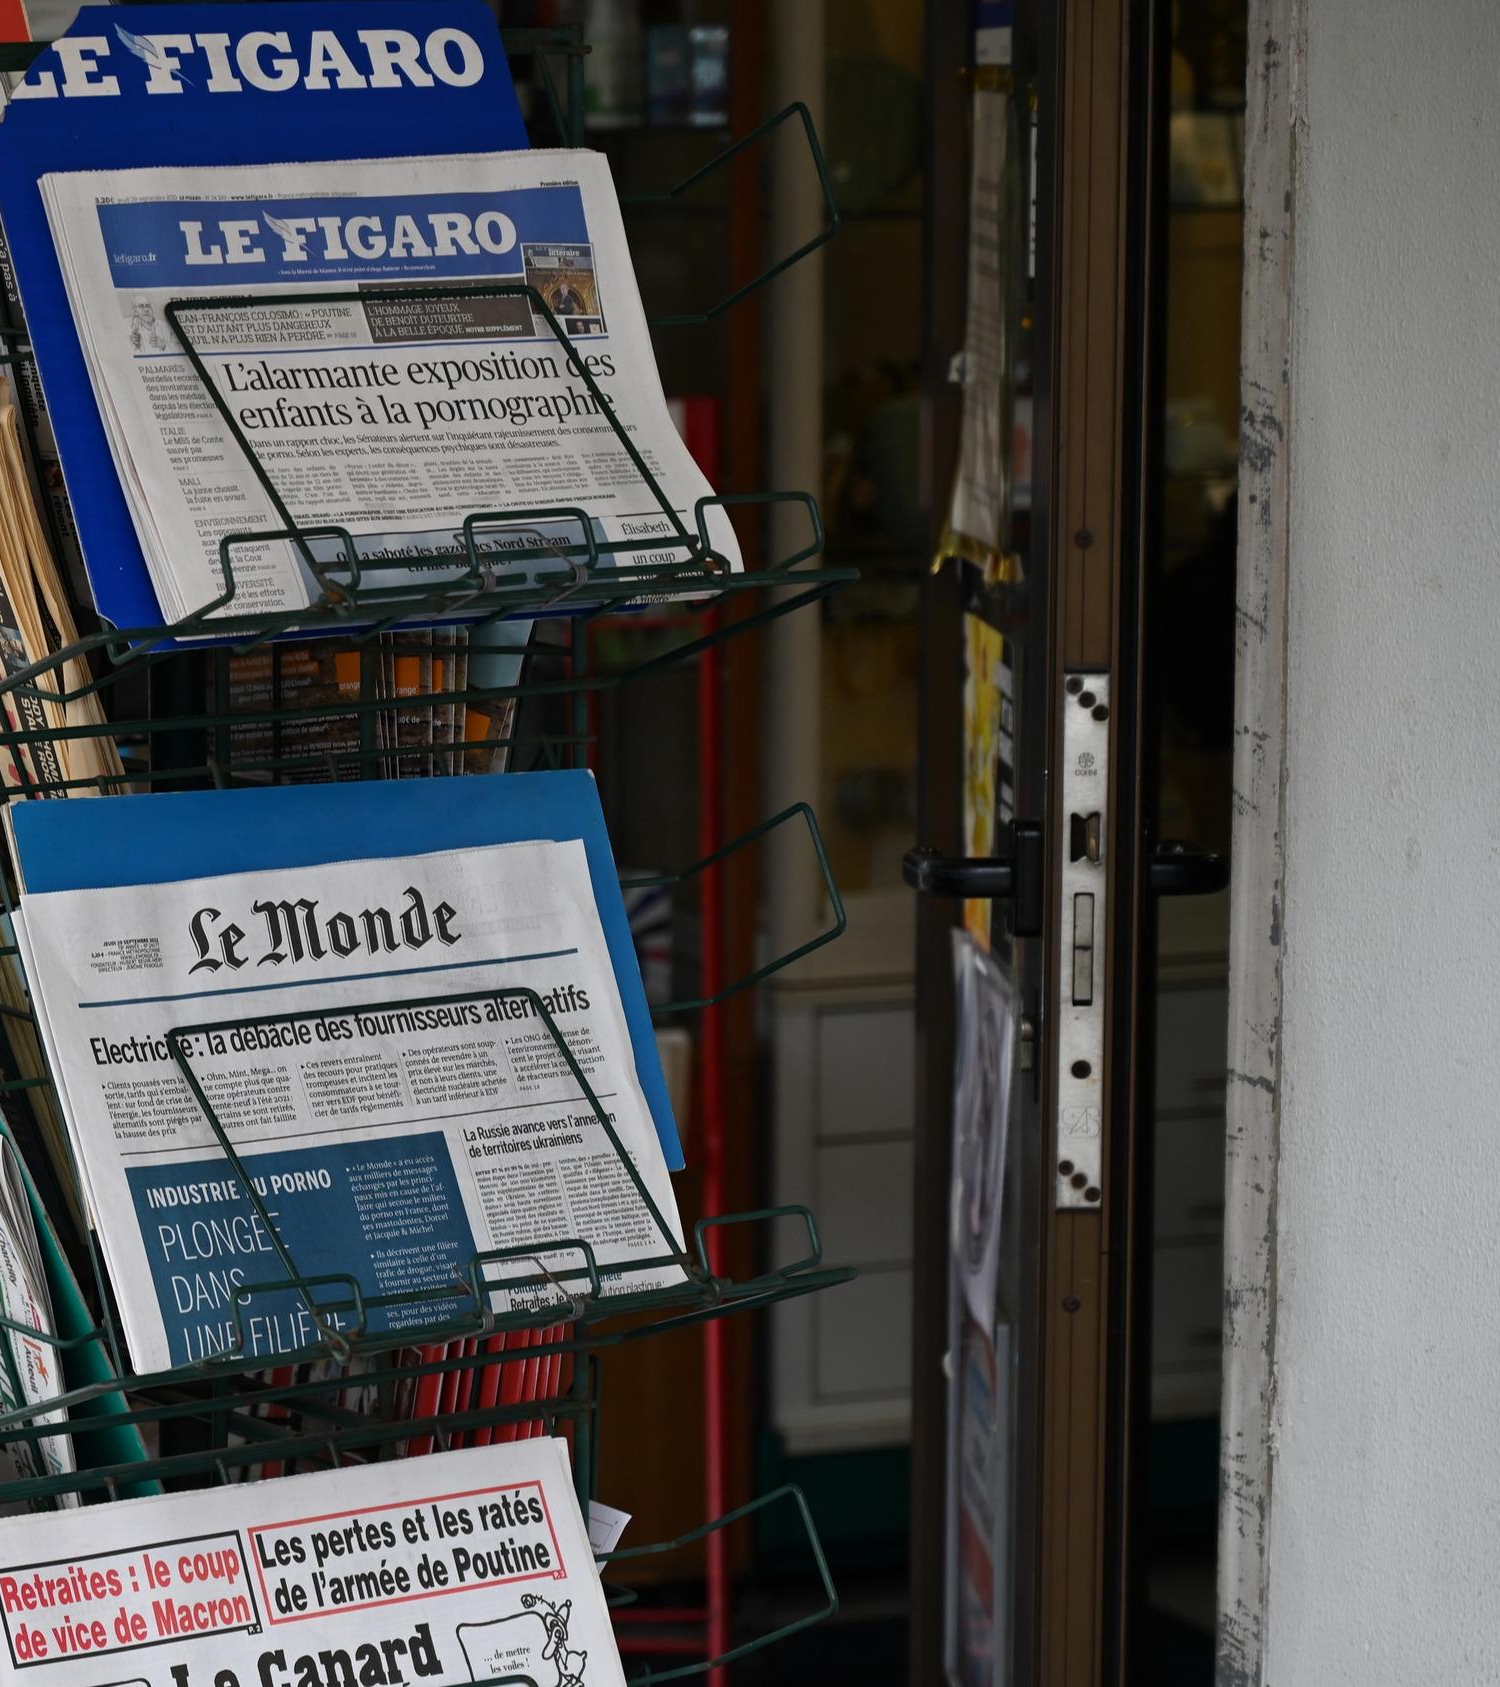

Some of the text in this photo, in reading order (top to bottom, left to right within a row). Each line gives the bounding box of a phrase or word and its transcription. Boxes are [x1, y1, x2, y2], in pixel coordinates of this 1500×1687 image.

[9, 28, 486, 99] LE FIGARO
[179, 211, 517, 265] LE FIGARO
[114, 252, 157, 265] lefigaro.fr
[0, 265, 13, 290] pas
[312, 308, 352, 318] POUTINE
[367, 303, 460, 316] L'HOMMAGE JOYEUX
[371, 317, 384, 327] DE
[421, 313, 475, 324] DUTEURTRE
[197, 319, 332, 334] D'AUTANT PLUS DANGEREUX
[383, 327, 397, 337] LA
[398, 326, 426, 336] BELLE
[427, 323, 464, 335] ÉPOQUE
[221, 360, 401, 392] L'alarmante
[407, 351, 559, 390] exposition
[239, 397, 353, 429] enfants
[357, 397, 377, 424] à
[378, 394, 411, 424] la
[248, 439, 272, 449] Dans
[272, 439, 285, 447] un
[285, 438, 319, 447] rapport
[319, 435, 343, 445] choc,
[342, 434, 356, 444] les
[355, 433, 398, 443] Sénateurs
[397, 432, 431, 442] alertent
[445, 430, 493, 440] l'inquiétant
[493, 427, 556, 438] rajeunissement
[556, 426, 572, 435] des
[621, 521, 671, 535] Élisabeth
[494, 539, 524, 550] Nord
[632, 552, 676, 566] un coup
[188, 907, 249, 975] Le
[251, 886, 462, 968] Monde
[90, 1034, 195, 1065] Electricié
[205, 1030, 226, 1056] la
[230, 1018, 311, 1052] débâcle
[315, 1016, 353, 1042] des
[353, 1002, 482, 1038] fournisseurs
[407, 1040, 497, 1057] Des opérateurs sont soup-
[106, 1081, 131, 1089] Clients
[131, 1077, 160, 1089] poussés
[176, 1075, 184, 1084] la
[463, 1110, 617, 1143] La Russie avance vers l'annexn
[469, 1131, 584, 1158] de territoires ukrainiens
[348, 1165, 437, 1182] aux milliers de messages
[146, 1180, 240, 1209] INDUSTRIE
[271, 1168, 332, 1195] PORNO
[364, 1223, 434, 1240] et Jacquie & Michel
[171, 1267, 253, 1314] DANS
[23, 1346, 38, 1396] Auteuil
[257, 1490, 545, 1570] Les pertes et les ratés
[145, 1550, 172, 1591] le
[176, 1544, 242, 1592] coup
[273, 1578, 305, 1617] de
[311, 1560, 412, 1610] l'armée
[415, 1553, 449, 1591] de
[455, 1535, 552, 1583] Poutine
[14, 1623, 47, 1661] de
[51, 1612, 109, 1653] vice
[114, 1603, 149, 1644] de
[153, 1592, 253, 1637] Macron
[256, 1622, 445, 1687] Canard
[494, 1646, 531, 1661] de mettre
[490, 1664, 501, 1675] les
[502, 1661, 525, 1673] voiles
